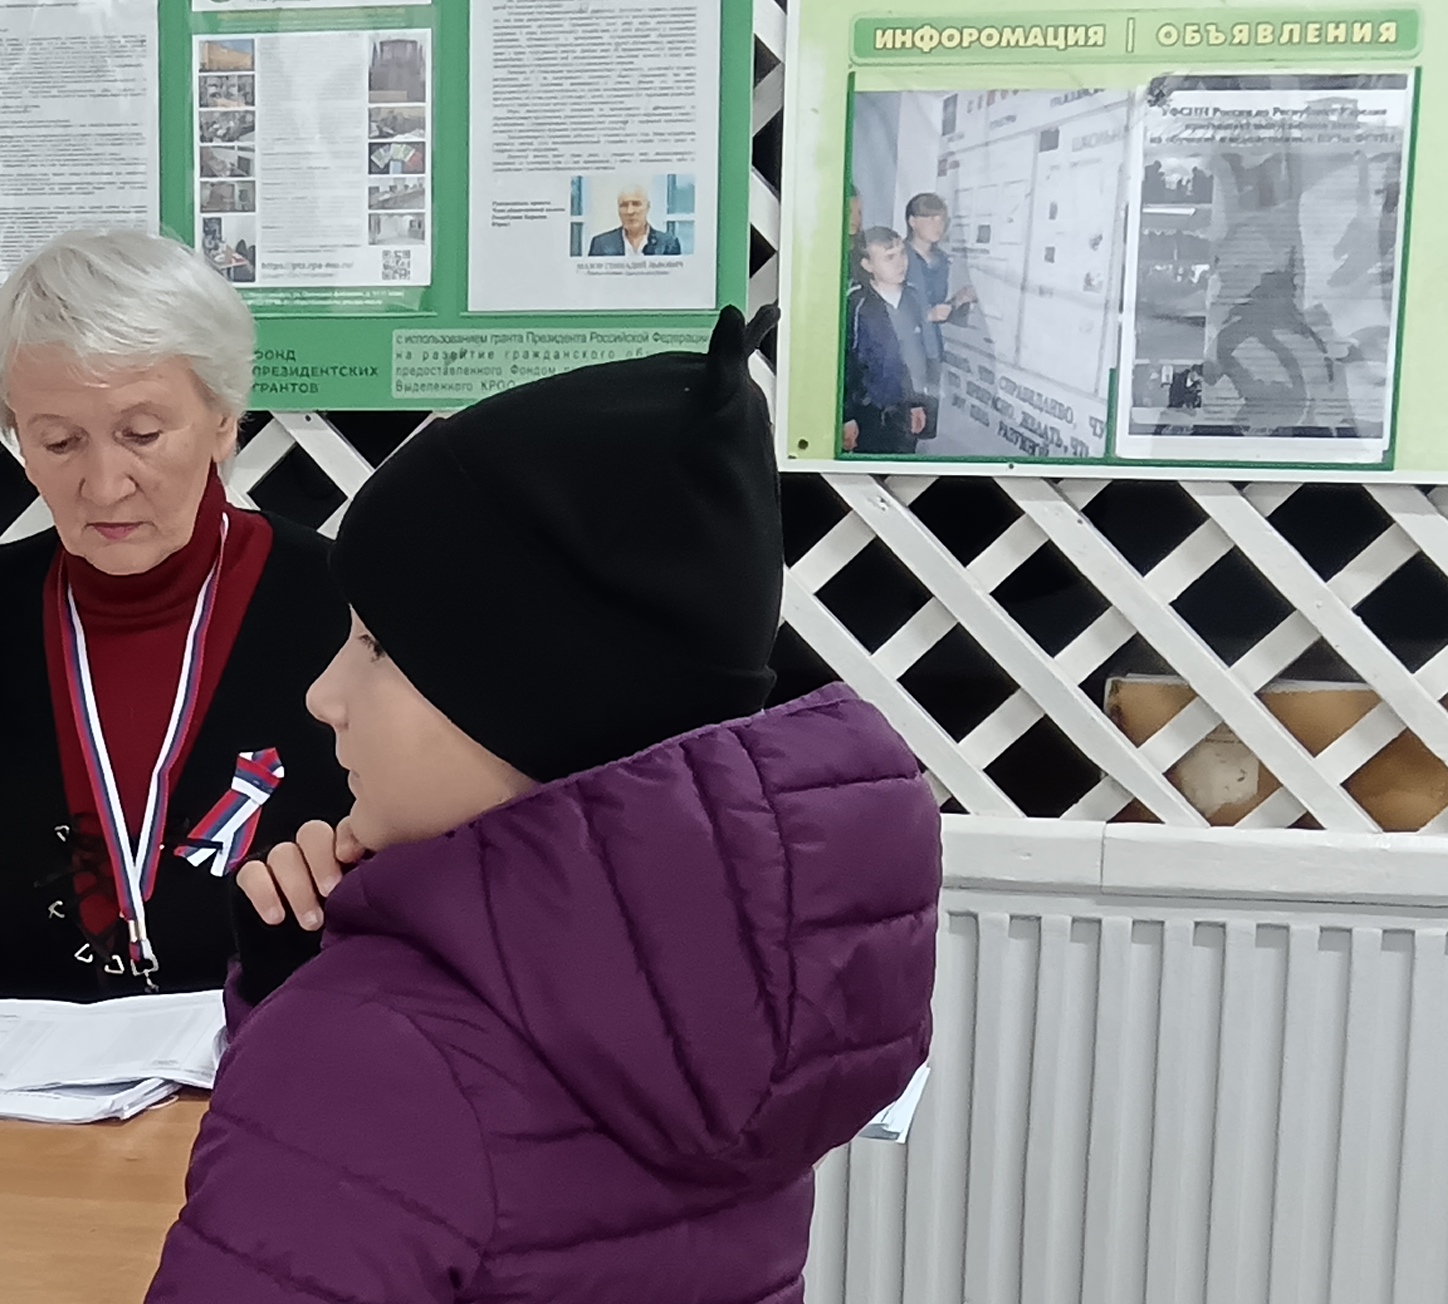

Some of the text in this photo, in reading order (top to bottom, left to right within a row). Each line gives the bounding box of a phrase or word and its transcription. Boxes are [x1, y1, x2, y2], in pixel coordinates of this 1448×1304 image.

[874, 24, 1105, 53] ИНФОРОМАЦИЯ
[1156, 21, 1398, 47] ОБЪЯВЛЕНИЯ
[405, 333, 488, 346] использованием
[491, 333, 524, 346] гранта
[526, 331, 587, 345] Президента
[589, 331, 649, 344] Российской
[396, 347, 649, 362] на развитие гражданского об
[252, 365, 379, 379] ПРЕЗИДЕНТСКИХ
[395, 364, 556, 378] предоставленного Фондом
[252, 382, 320, 395] ГРАНТОВ
[395, 380, 474, 393] Выделенного
